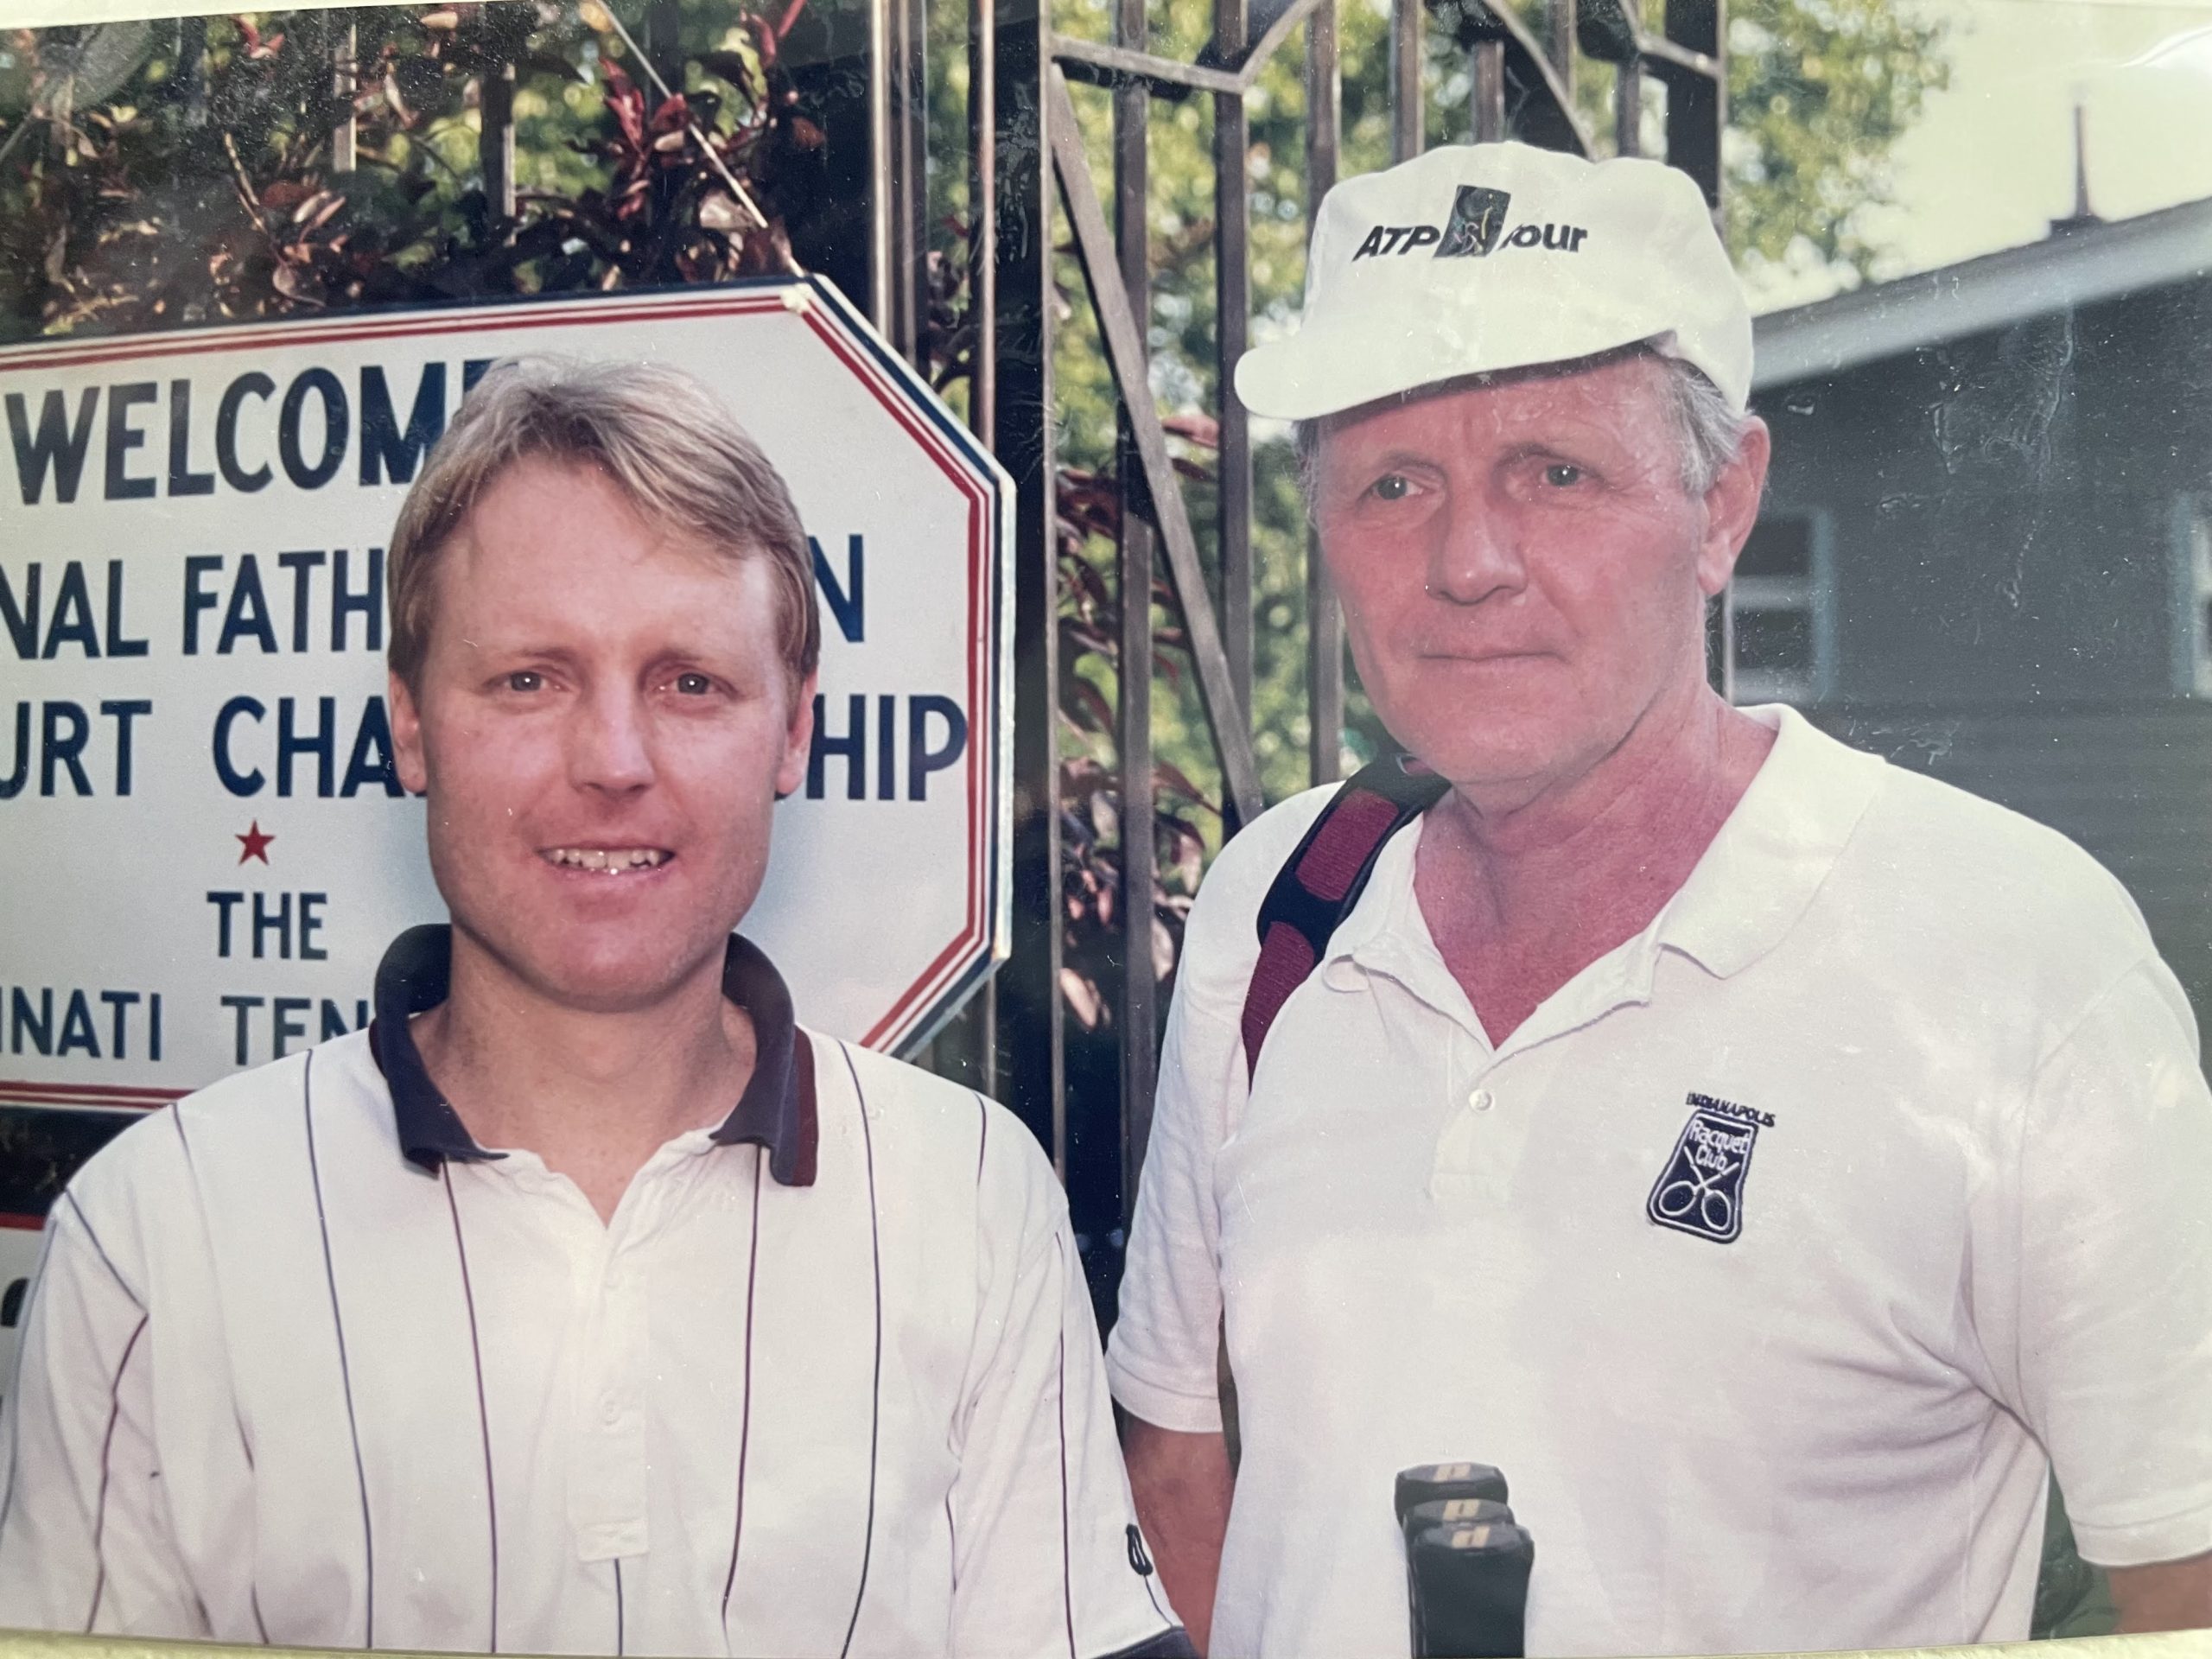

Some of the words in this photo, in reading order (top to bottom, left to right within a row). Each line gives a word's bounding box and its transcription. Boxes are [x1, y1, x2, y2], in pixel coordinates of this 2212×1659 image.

[1351, 225, 1440, 262] ATP
[5, 359, 517, 505] WELCOM
[213, 695, 427, 798] CHA
[774, 694, 969, 802] HIP
[207, 892, 328, 961] THE
[0, 986, 162, 1061] NATI
[1689, 1119, 1751, 1154] Racquet
[1694, 1145, 1728, 1172] Club
